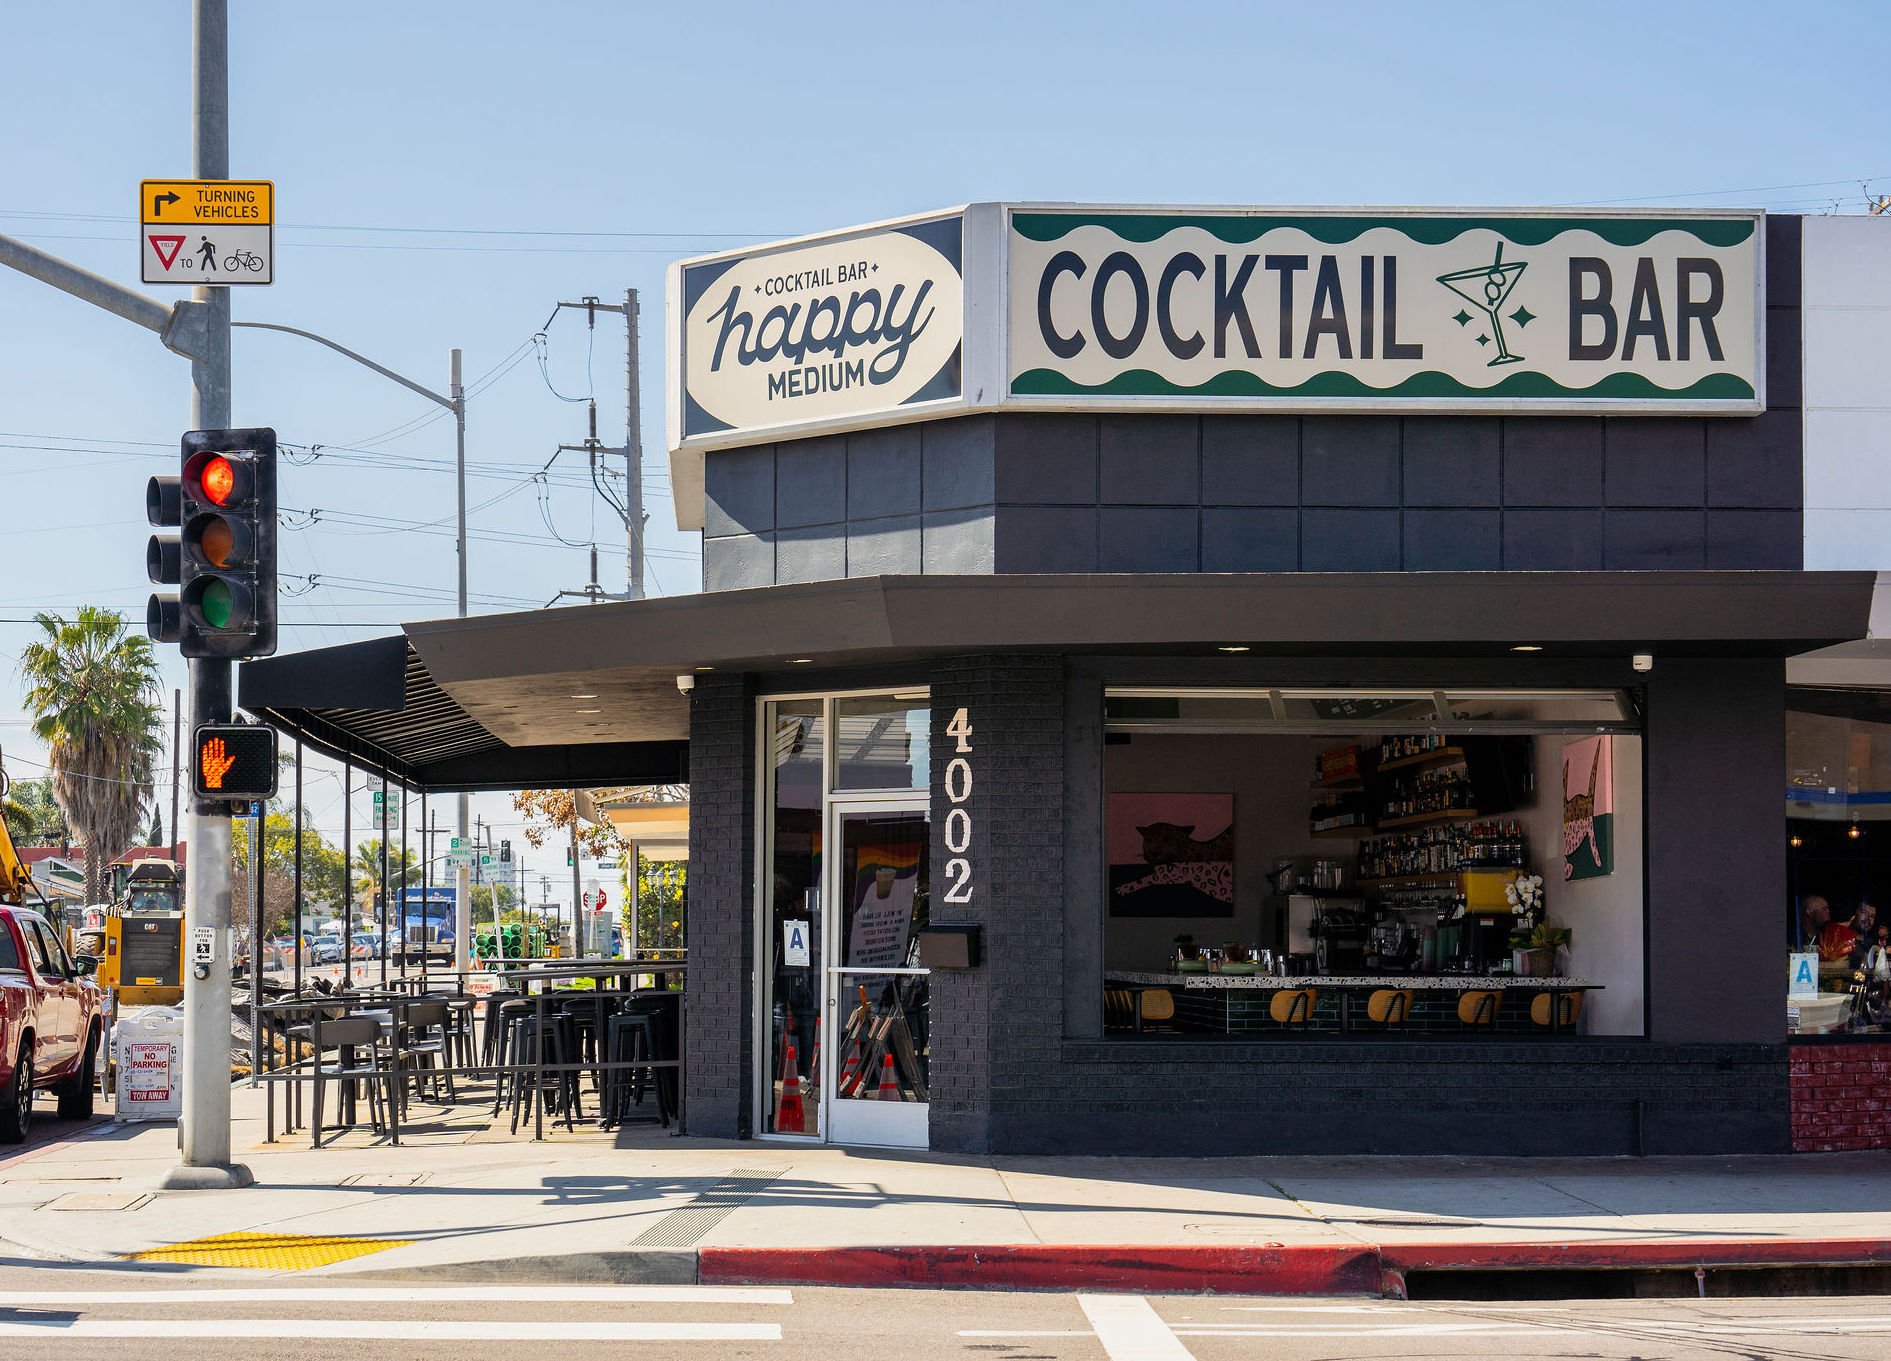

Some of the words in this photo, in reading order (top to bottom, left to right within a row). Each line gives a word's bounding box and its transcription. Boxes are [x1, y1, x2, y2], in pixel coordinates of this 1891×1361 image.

[197, 190, 254, 202] TURNING
[194, 206, 258, 218] VEHICLES
[180, 258, 192, 268] TO
[764, 268, 834, 296] COCKTAIL
[838, 261, 868, 283] BAR
[1037, 250, 1424, 361] COCKTAIL
[1568, 256, 1725, 362] BAR
[706, 279, 936, 386] happy
[768, 358, 865, 401] MEDIUM
[944, 707, 974, 904] 4002
[790, 928, 804, 949] A
[1796, 960, 1812, 982] A
[133, 1092, 147, 1100] TOW
[148, 1092, 167, 1100] AWAY
